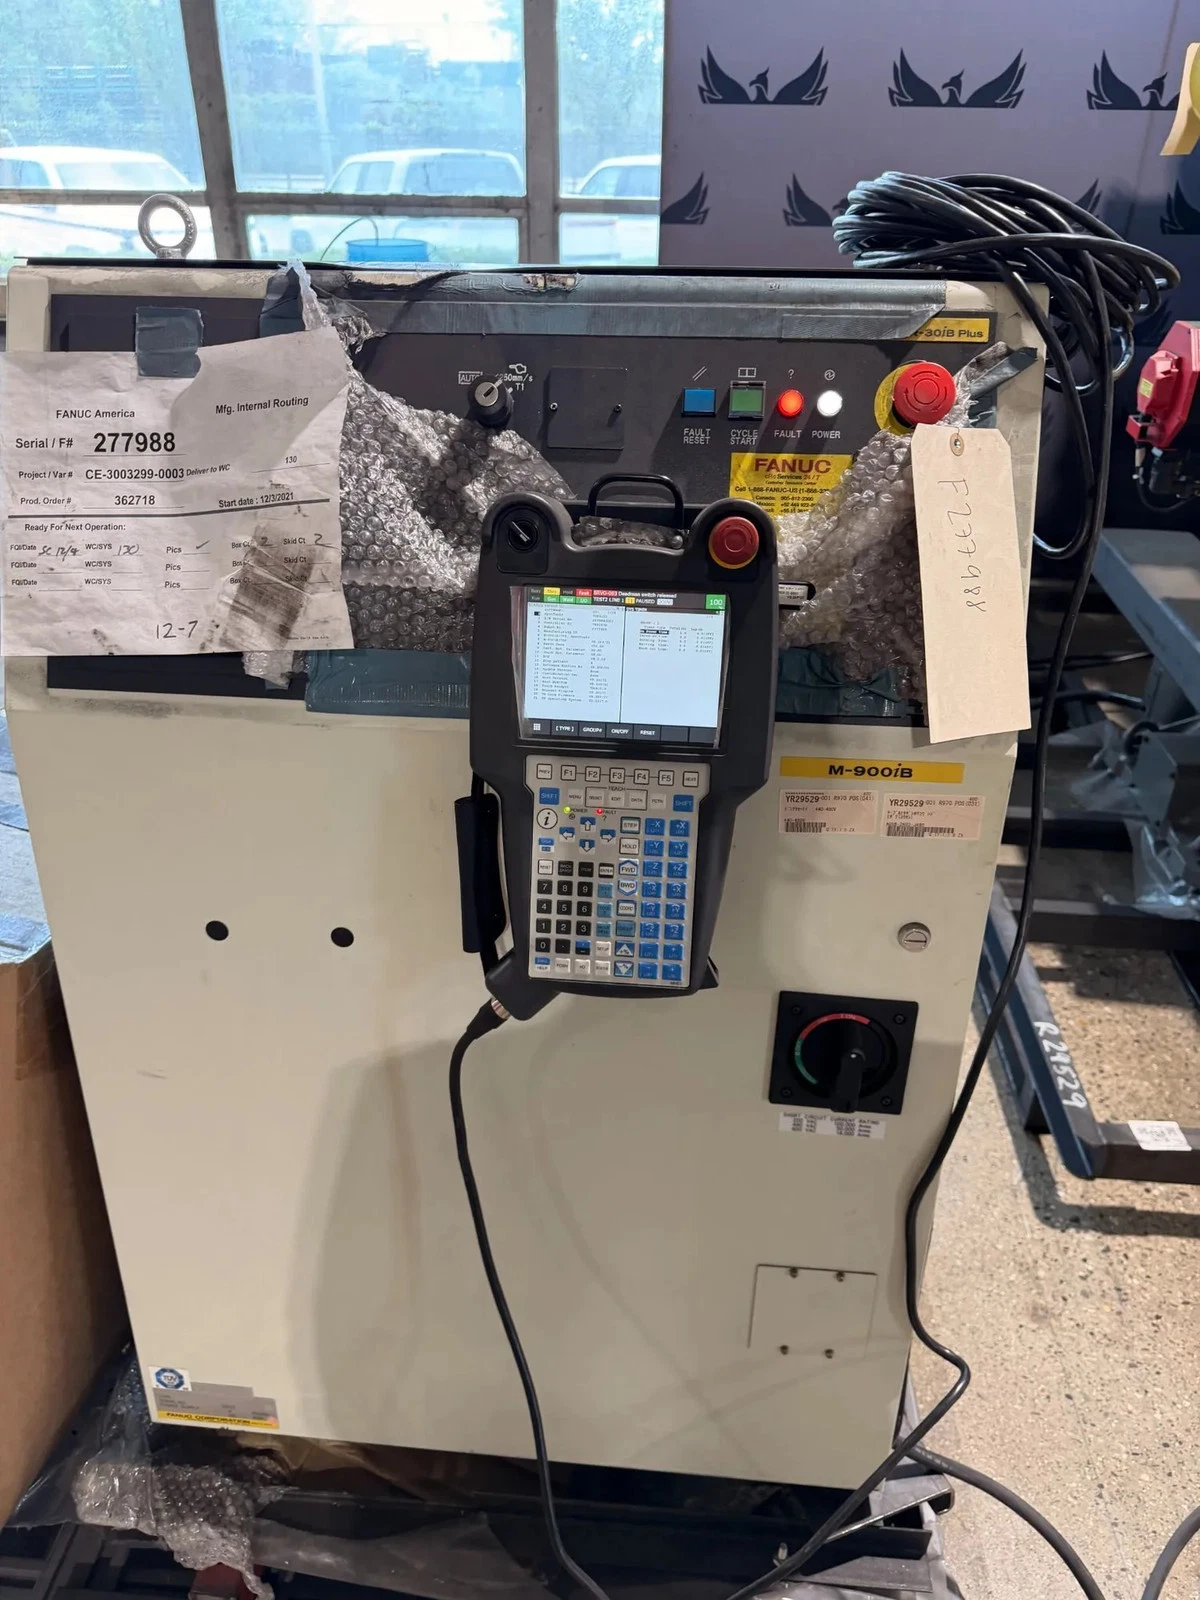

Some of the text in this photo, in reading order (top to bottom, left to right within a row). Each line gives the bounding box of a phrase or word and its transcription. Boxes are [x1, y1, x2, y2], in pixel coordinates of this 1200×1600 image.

[958, 330, 984, 338] Plus
[516, 382, 524, 391] T1
[216, 396, 309, 416] Mfg. Internal Routing
[56, 409, 135, 418] FANUC America
[683, 428, 710, 436] FAULT
[730, 429, 758, 438] CYCLE
[774, 429, 802, 438] FAULT
[812, 430, 840, 438] POWER
[16, 438, 74, 449] Serial / F#
[93, 432, 176, 453] 277988
[683, 436, 710, 444] RESET
[730, 437, 758, 445] START
[284, 456, 298, 464] 130
[186, 468, 208, 476] Deliver
[218, 464, 231, 472] WC
[754, 458, 832, 474] FANUC
[18, 471, 46, 480] Project
[48, 471, 52, 480] /
[85, 468, 185, 480] CE-3003299-0003
[42, 497, 64, 505] Order
[114, 495, 156, 506] 362718
[218, 499, 236, 508] Start
[239, 498, 254, 506] date
[260, 492, 294, 504] 12/3/2021
[24, 524, 48, 532] Ready
[84, 524, 126, 532] Operation:
[166, 546, 182, 554] Pics
[165, 563, 182, 571] Pics
[164, 580, 181, 589] Pics
[156, 620, 198, 639] 12-7
[828, 763, 914, 778] M-900iB
[785, 795, 820, 804] YR29529
[889, 798, 924, 808] YR29529
[166, 1412, 192, 1420] FANUC
